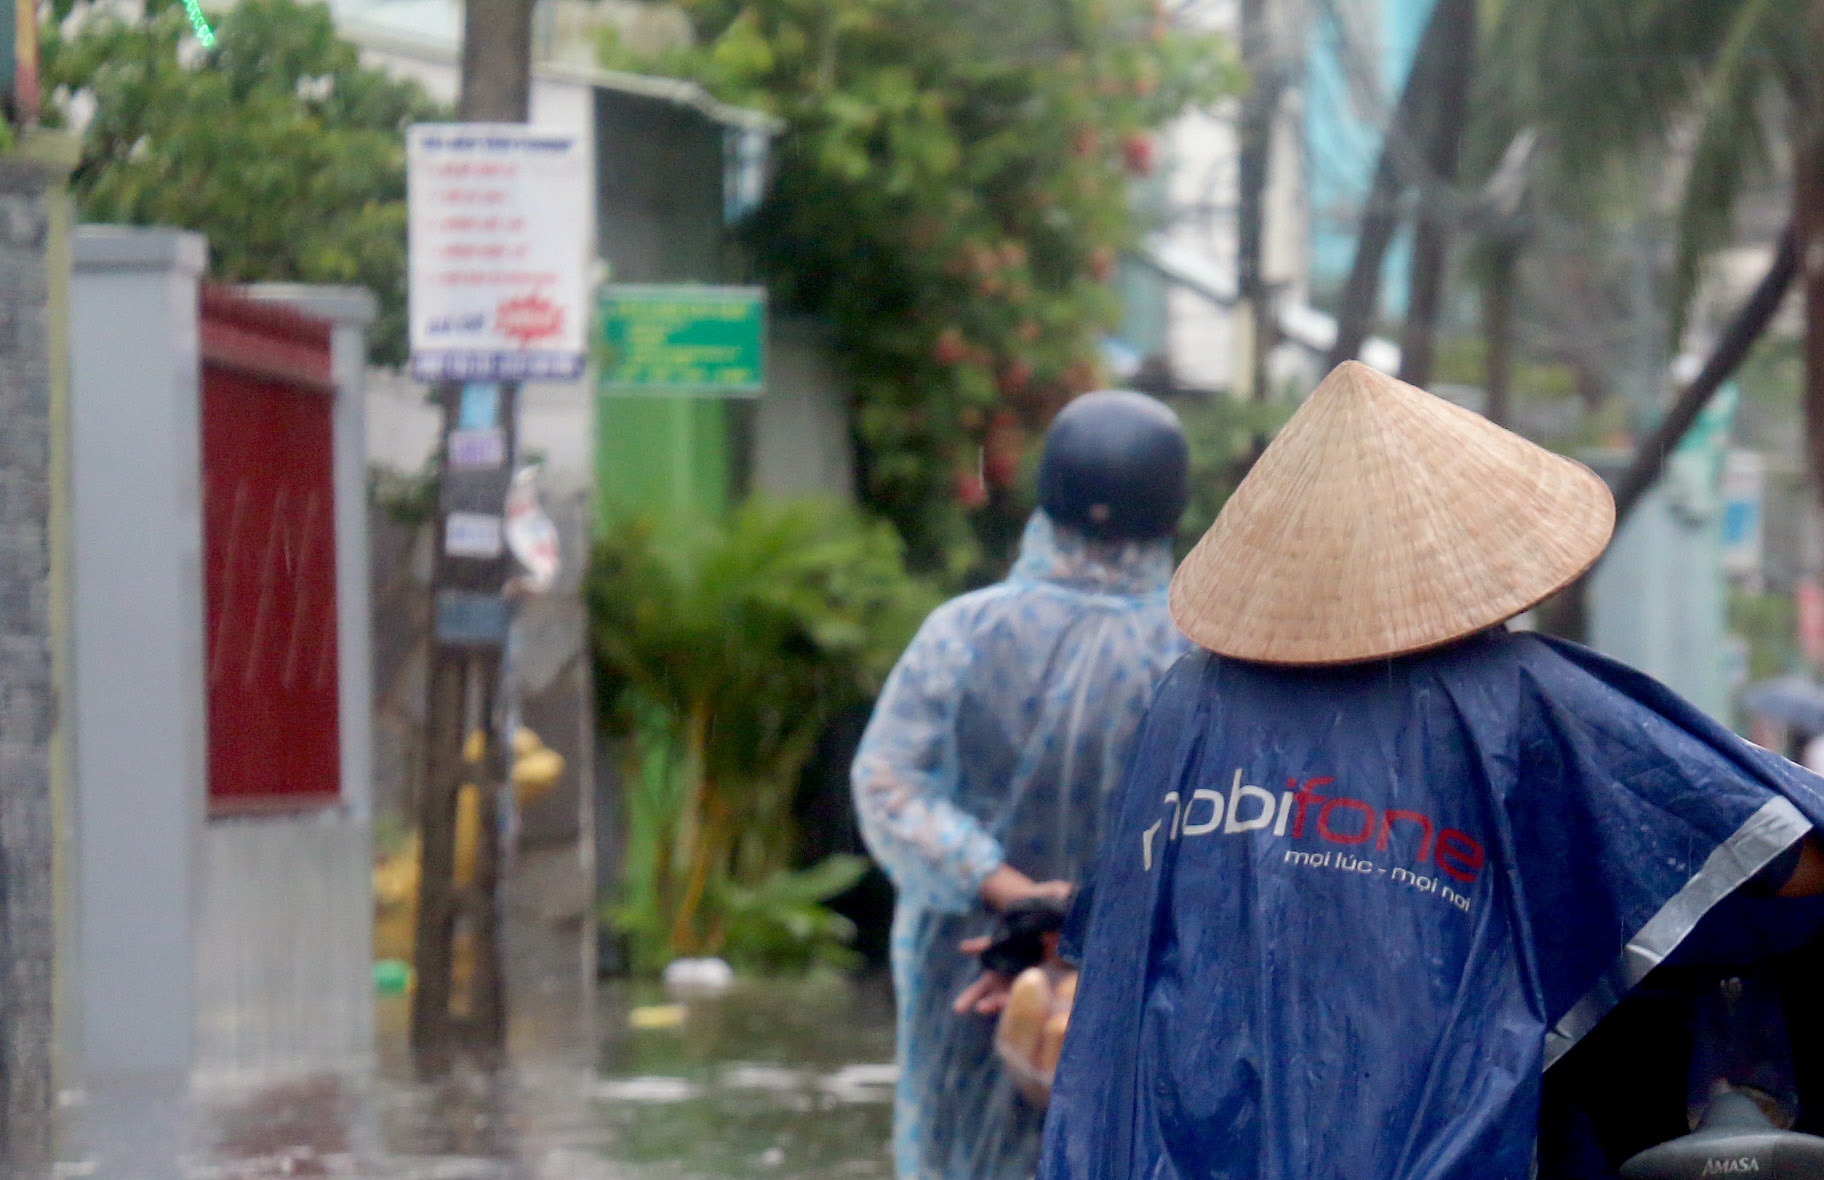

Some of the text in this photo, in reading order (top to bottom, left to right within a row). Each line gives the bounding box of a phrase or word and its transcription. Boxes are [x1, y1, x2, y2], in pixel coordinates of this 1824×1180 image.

[1284, 849, 1331, 868] mọi
[1335, 852, 1373, 874] lúc
[1391, 866, 1438, 892] mọi
[1702, 1157, 1760, 1176] AMASA
